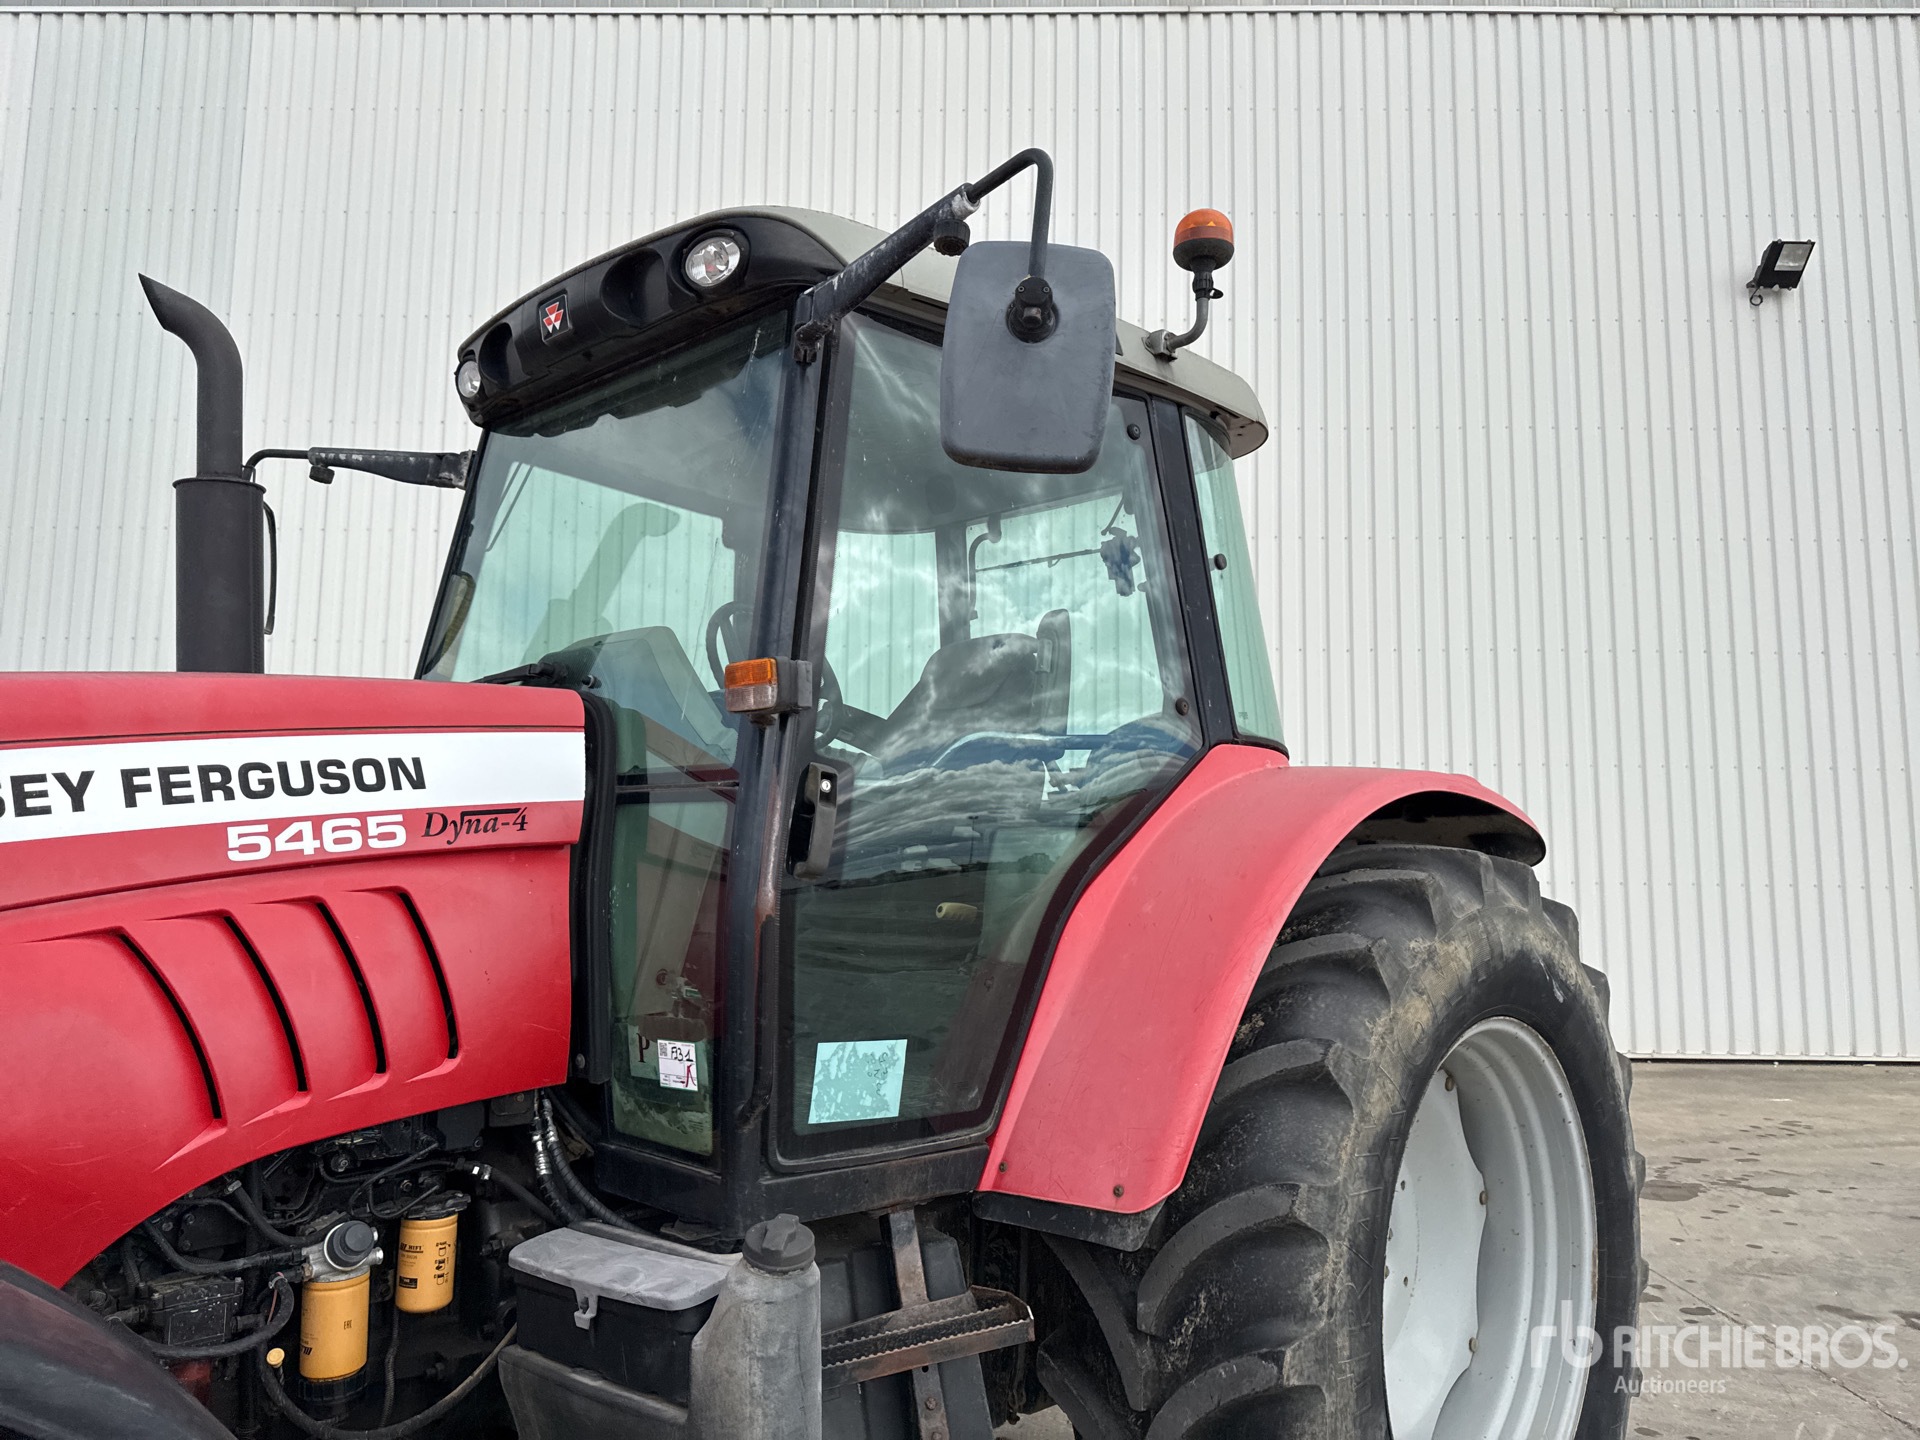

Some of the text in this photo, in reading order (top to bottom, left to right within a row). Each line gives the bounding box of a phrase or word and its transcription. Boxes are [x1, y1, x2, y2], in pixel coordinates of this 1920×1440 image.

[120, 757, 426, 808] FERGUSON
[227, 814, 407, 862] 5465
[421, 807, 528, 845] Dyna-4
